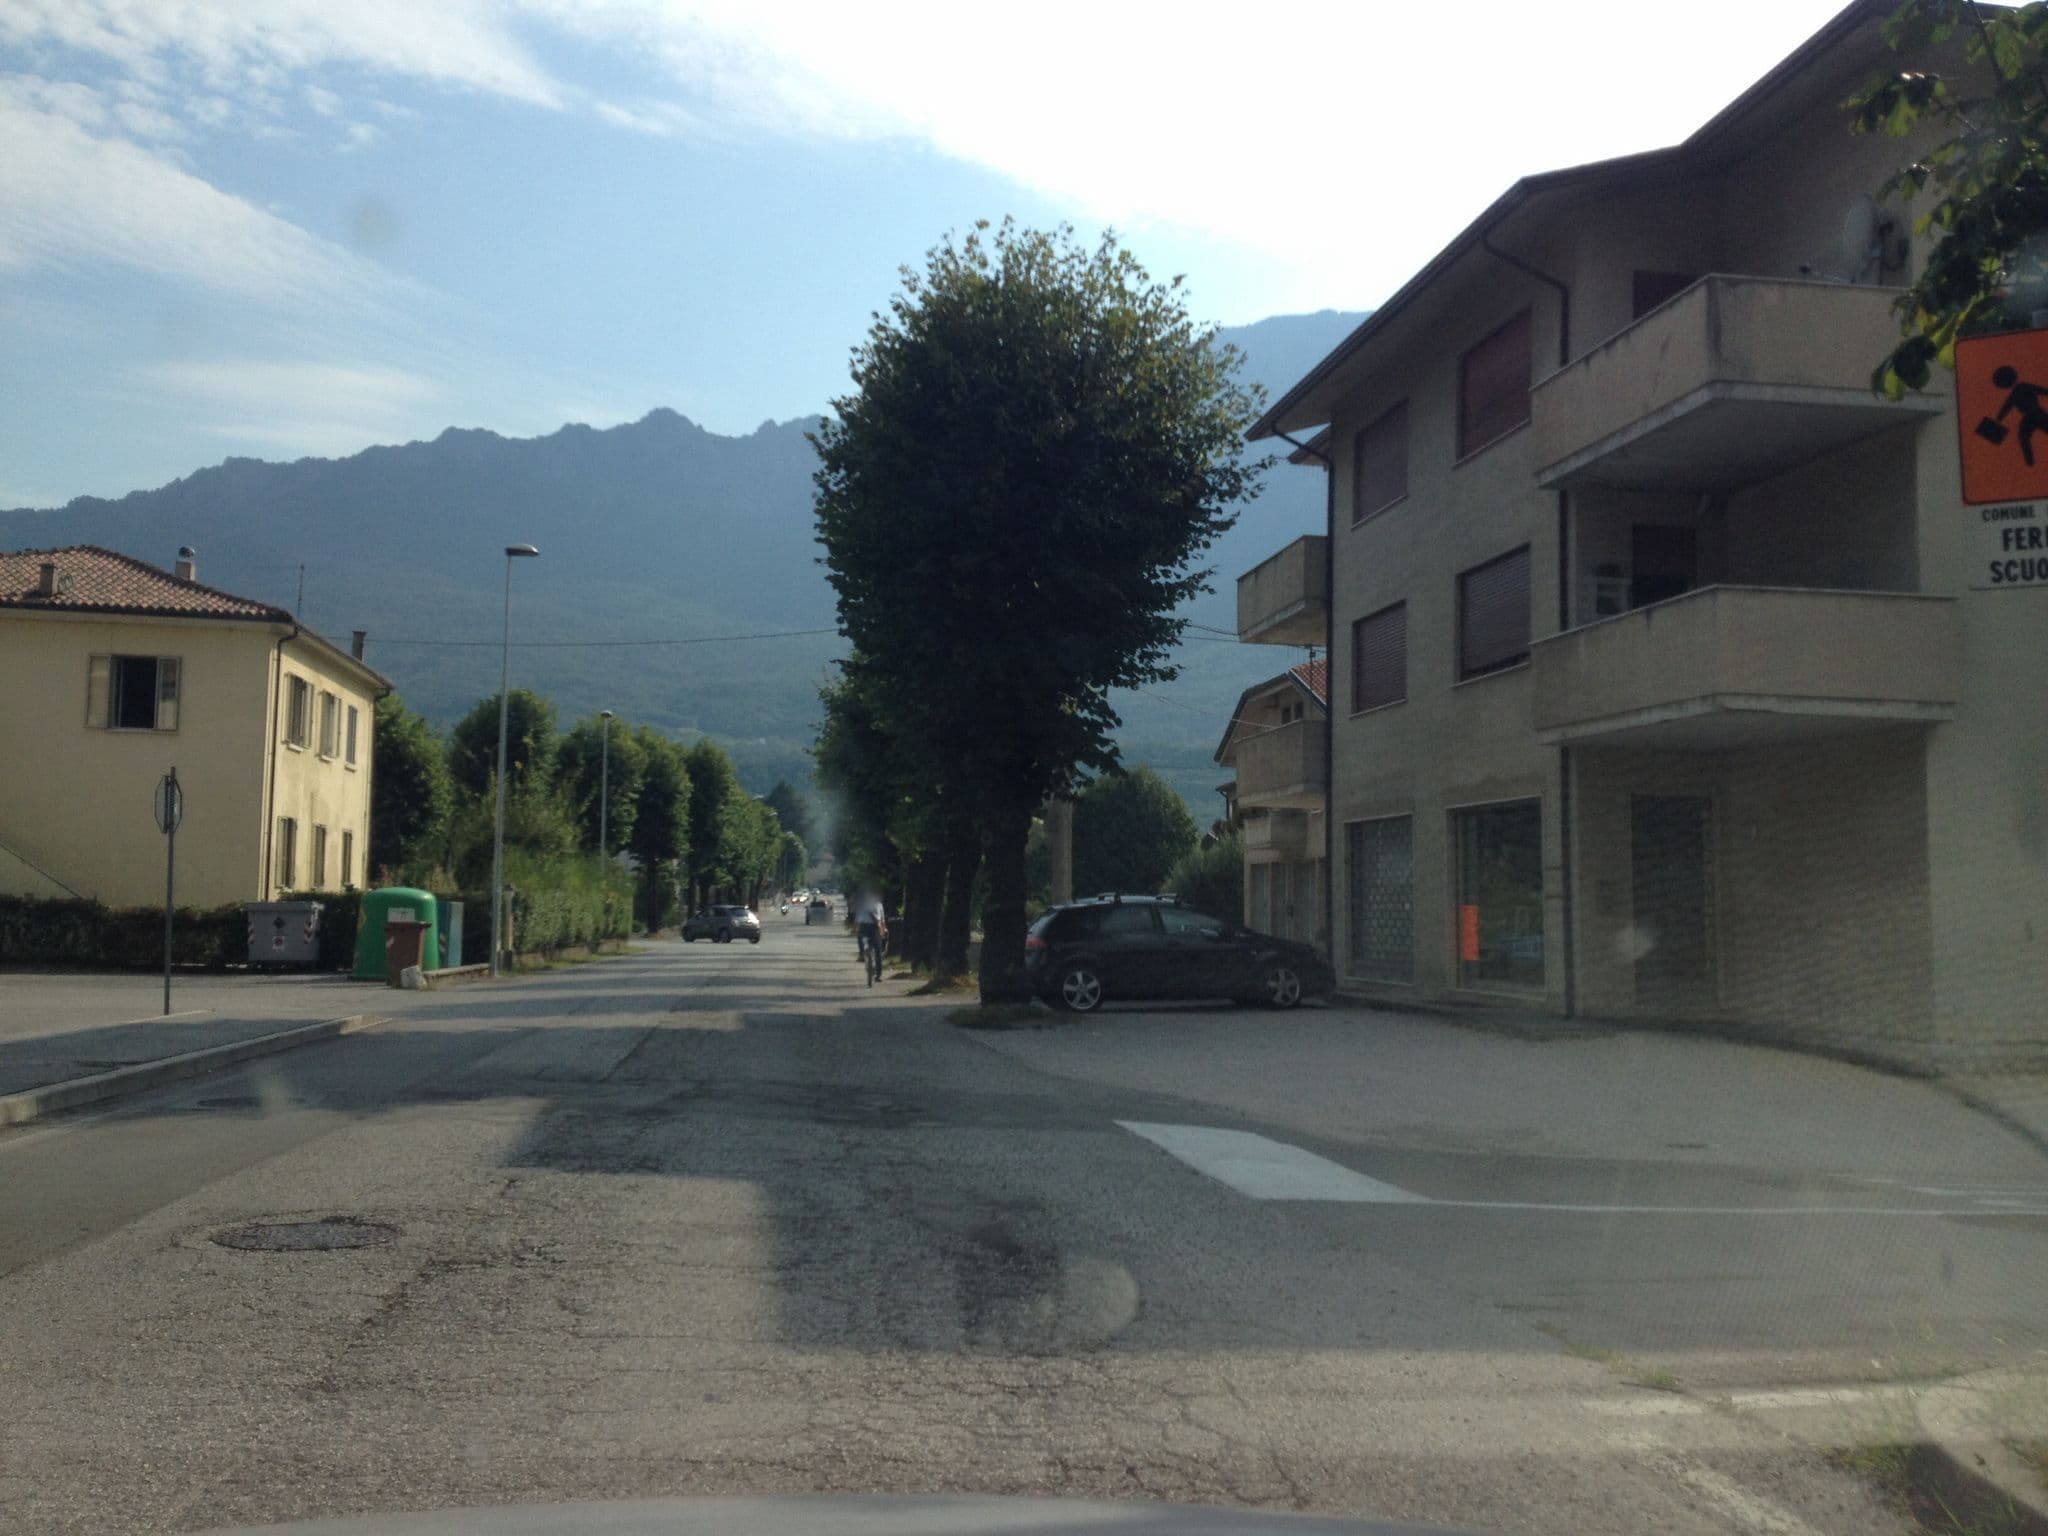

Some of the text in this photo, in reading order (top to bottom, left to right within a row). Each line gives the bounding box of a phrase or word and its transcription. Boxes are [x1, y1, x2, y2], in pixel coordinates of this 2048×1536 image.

[1983, 505, 2035, 521] COMUNE
[2003, 526, 2048, 551] FER
[1990, 558, 2048, 583] SCUO
